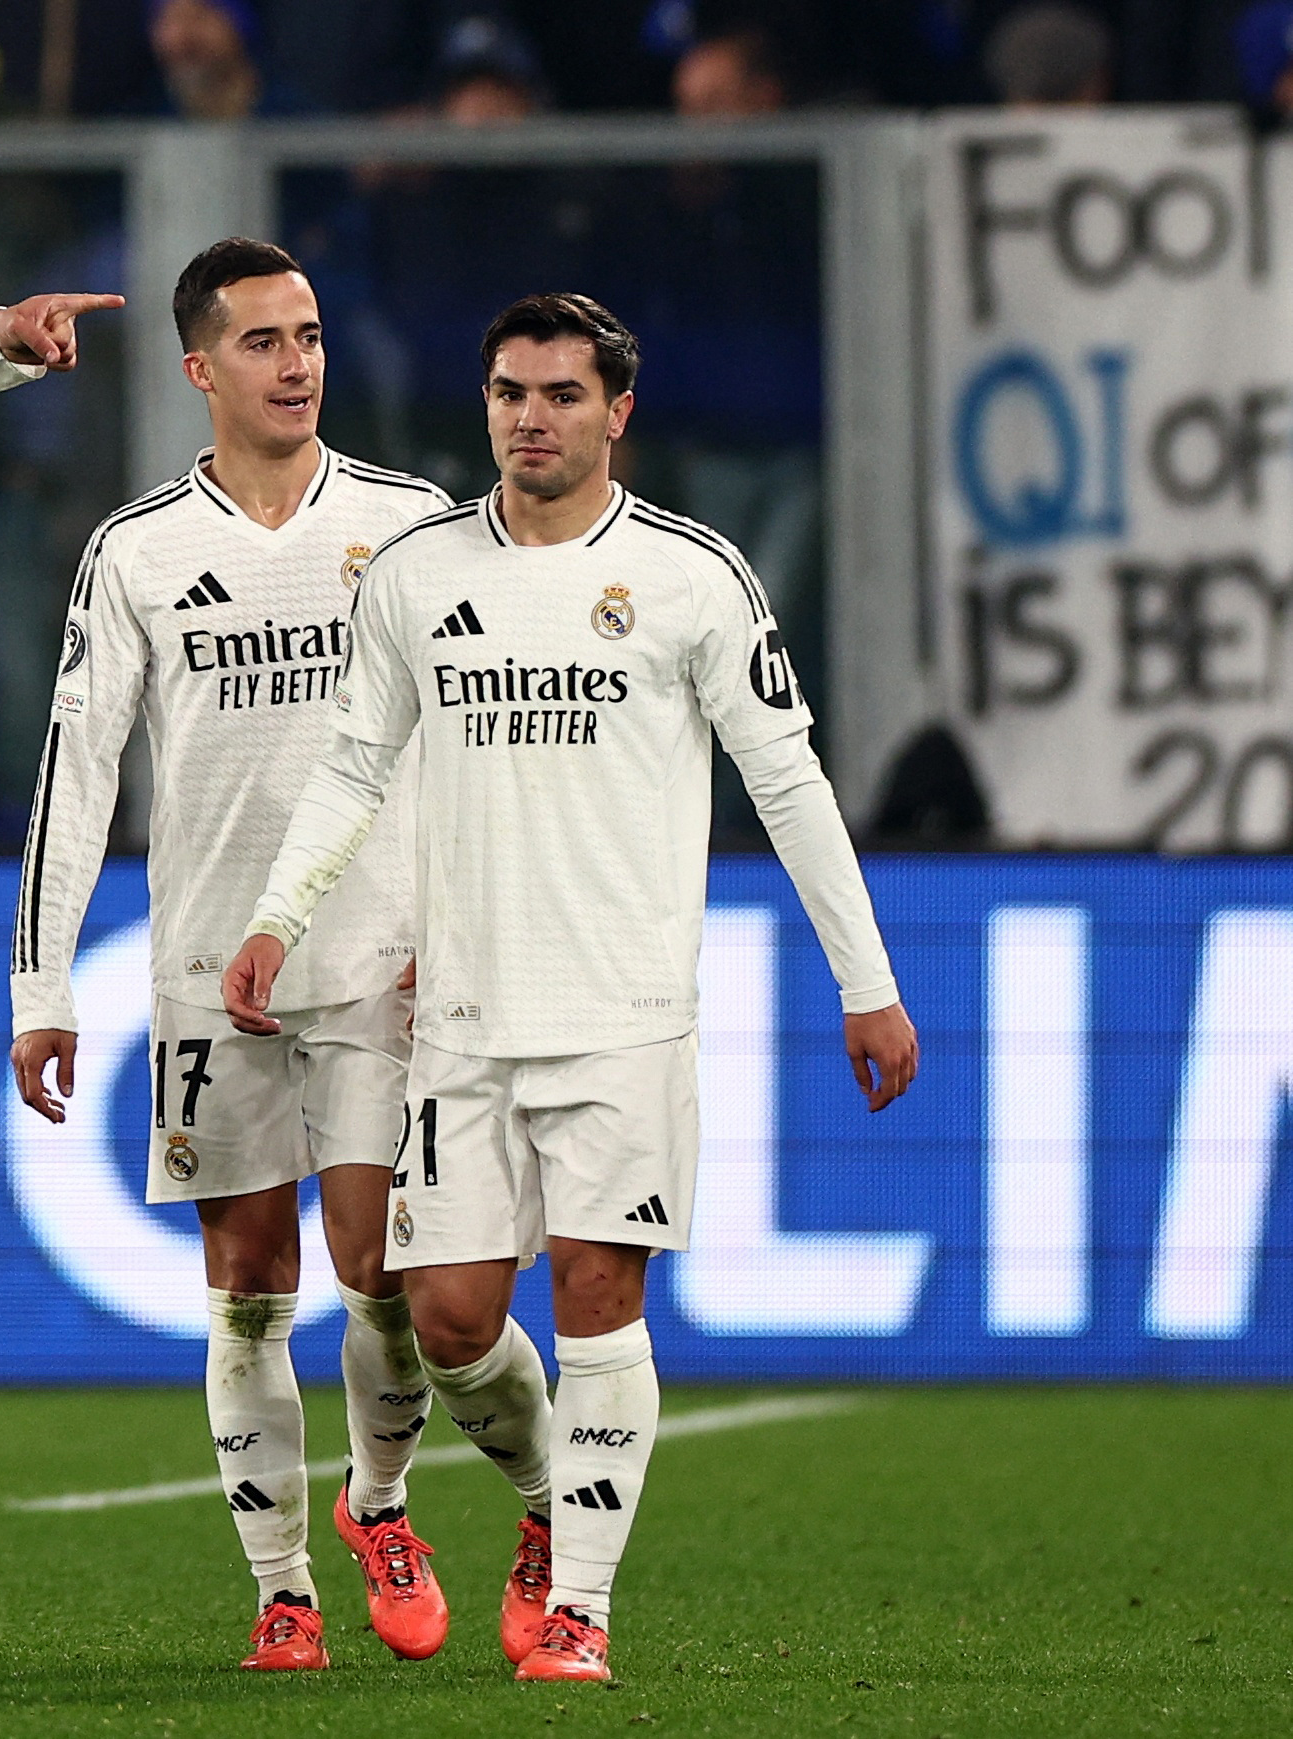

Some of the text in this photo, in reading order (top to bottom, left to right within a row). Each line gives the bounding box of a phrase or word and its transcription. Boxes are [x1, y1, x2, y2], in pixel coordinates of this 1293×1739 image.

[182, 616, 345, 672] Emirat
[219, 674, 260, 710] FLY
[434, 657, 628, 707] Emirates
[465, 710, 597, 747] FLY BETTER
[155, 1039, 213, 1128] 17
[392, 1098, 438, 1188] 21
[570, 1427, 637, 1447] RMCF
